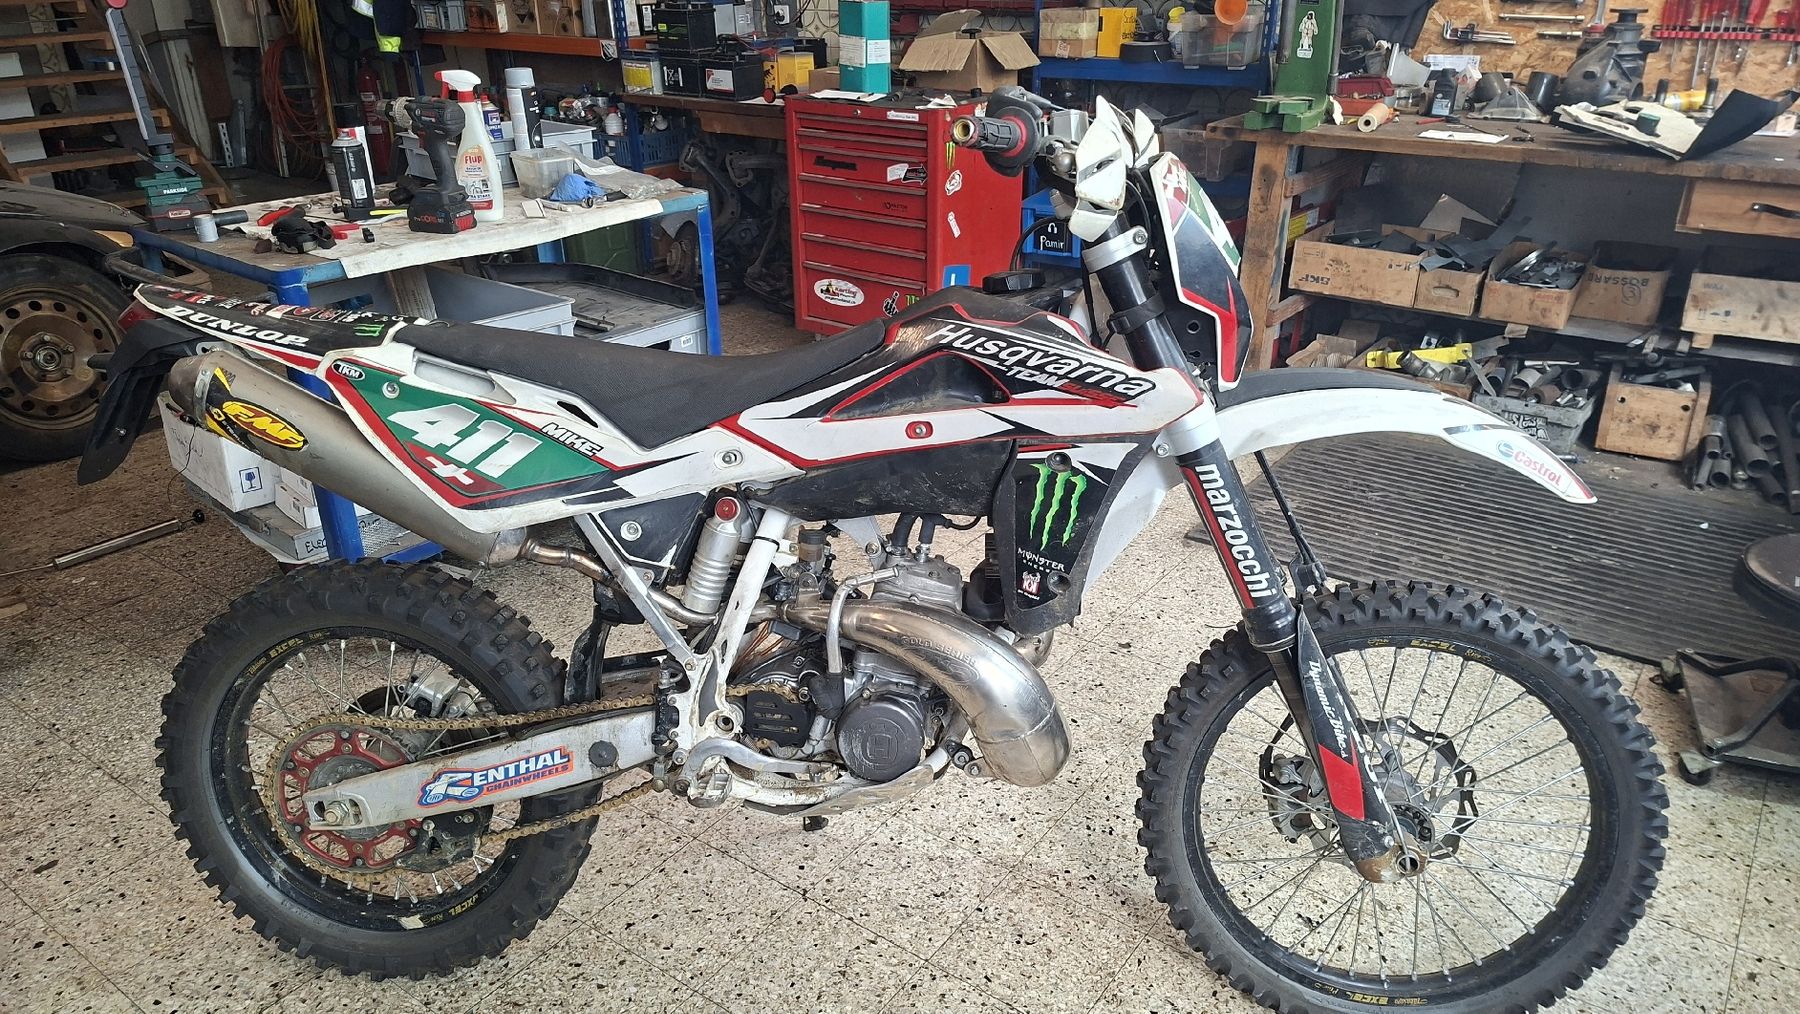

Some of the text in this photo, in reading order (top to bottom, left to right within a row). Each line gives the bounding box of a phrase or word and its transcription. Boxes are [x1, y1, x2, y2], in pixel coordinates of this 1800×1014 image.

[464, 155, 483, 164] Flup
[1040, 235, 1065, 251] Pamir
[1298, 273, 1331, 286] SKF
[1586, 272, 1650, 287] BOSSARD
[165, 304, 310, 348] DUNLOP
[925, 324, 1154, 396] Husqvarna
[1007, 366, 1070, 388] TEAM
[222, 401, 305, 446] FMF
[387, 402, 542, 479] 411
[540, 422, 602, 457] MIKE
[1513, 450, 1563, 487] Castrol
[1195, 463, 1276, 598] marzocchi
[1017, 547, 1065, 572] MONSTER
[268, 637, 304, 658] EXCEL
[425, 749, 569, 803] RENTHAL
[486, 764, 569, 793] CHAINWHEELS
[1345, 991, 1389, 1005] EXCEL
